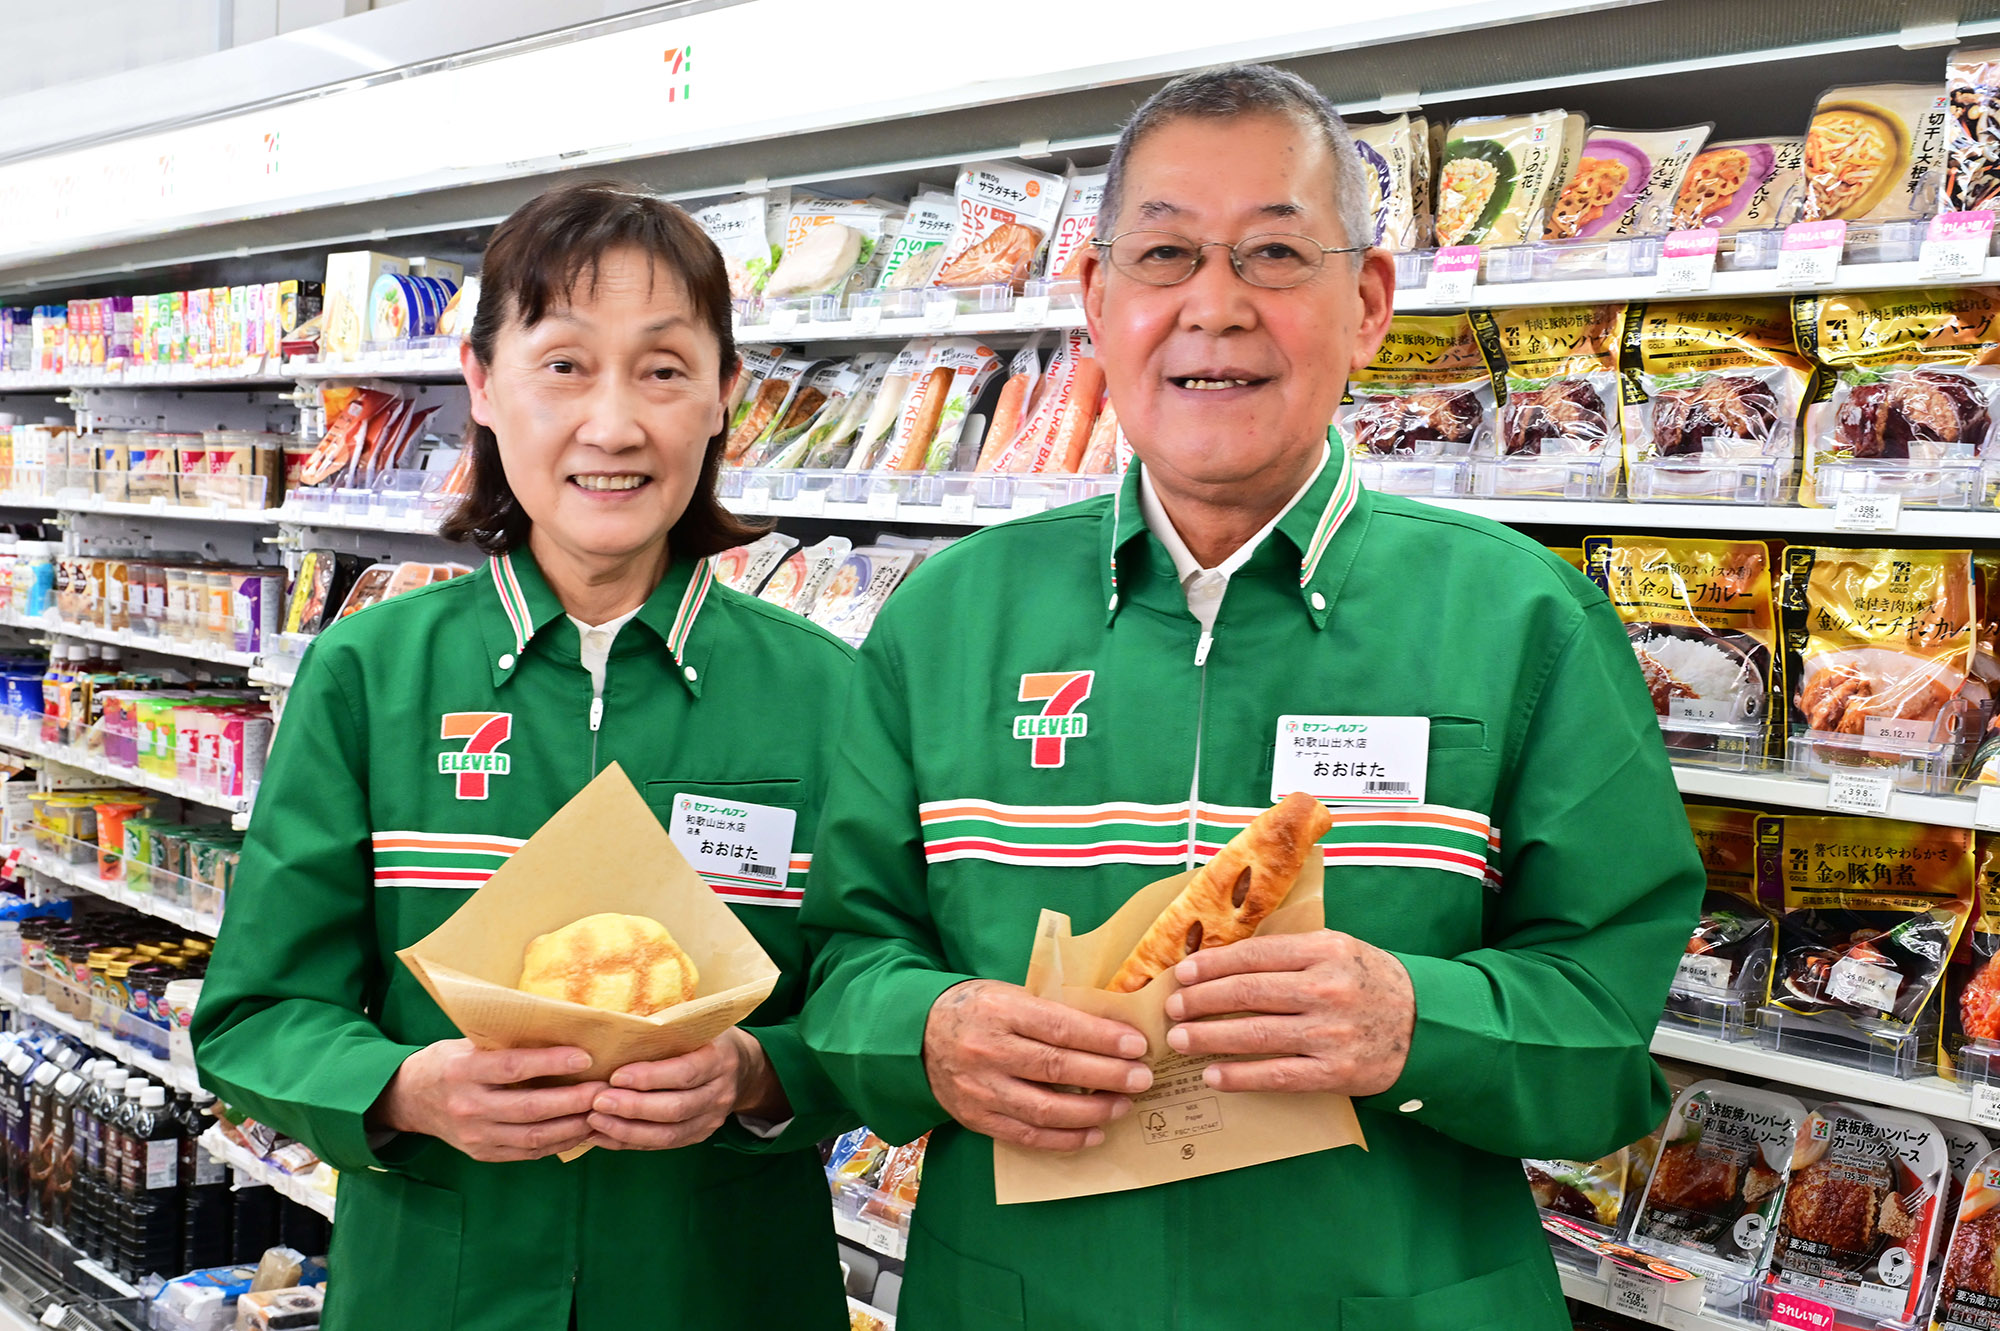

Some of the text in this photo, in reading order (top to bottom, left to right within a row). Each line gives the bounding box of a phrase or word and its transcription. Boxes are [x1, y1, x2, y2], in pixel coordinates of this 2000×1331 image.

[979, 181, 1027, 202] サラダチキン
[1648, 342, 1665, 350] GOLD
[1045, 408, 1064, 446] CRAB
[1880, 728, 1916, 739] 25.12.17
[1294, 737, 1368, 749] 和歌山出水店
[1313, 761, 1386, 778] おおはた
[686, 815, 746, 833] 和歌山出水店
[686, 827, 701, 836] 店長
[700, 839, 759, 861] おおはた
[1813, 842, 1949, 862] 箸でほぐれるやわらかさ
[1789, 875, 1808, 883] GOLD
[1814, 860, 1917, 887] 金の豚角煮
[1185, 1112, 1204, 1122] Paper
[1708, 1101, 1793, 1132] 鉄板焼ハンバーグ
[1704, 1117, 1788, 1147] 和風おろしソース
[1834, 1117, 1931, 1147] 鉄板焼ハンバーグ
[1832, 1135, 1921, 1163] ガーリックソース
[1844, 1171, 1869, 1183] 135 301
[1789, 1237, 1818, 1254] 要冷蔵
[1955, 1290, 1986, 1307] 要冷蔵
[1777, 1302, 1830, 1328] うれしい値!
